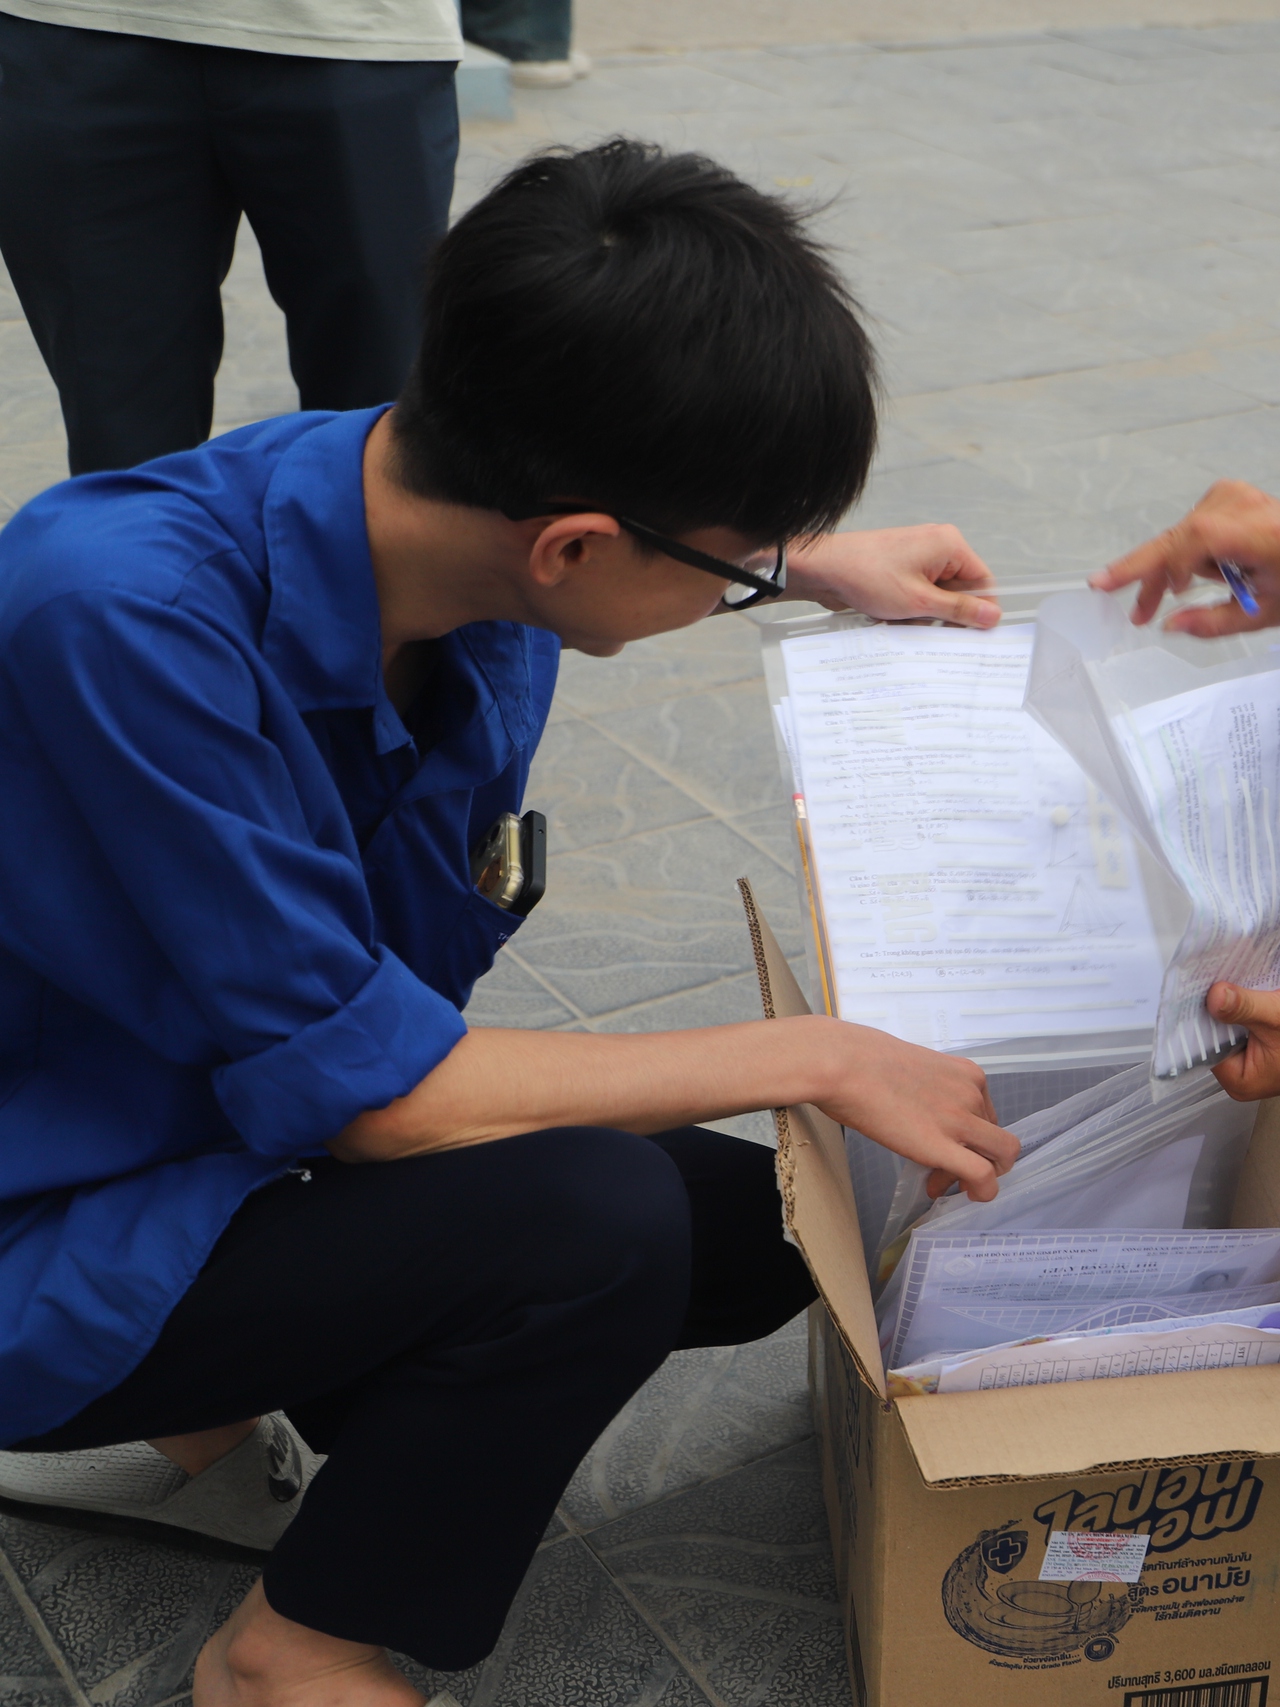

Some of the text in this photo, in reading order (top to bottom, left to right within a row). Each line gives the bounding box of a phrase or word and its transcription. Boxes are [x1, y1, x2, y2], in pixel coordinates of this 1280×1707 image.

[1127, 1585, 1159, 1602] สูตร
[1162, 1565, 1252, 1595] อนามัย
[1154, 1606, 1221, 1621] ไร้กลิ่นติดจาน
[1062, 1658, 1082, 1667] Flavor
[1107, 1660, 1271, 1689] ปริมาณสุทธิ 3,600 มล.ชนิดแกลลอน
